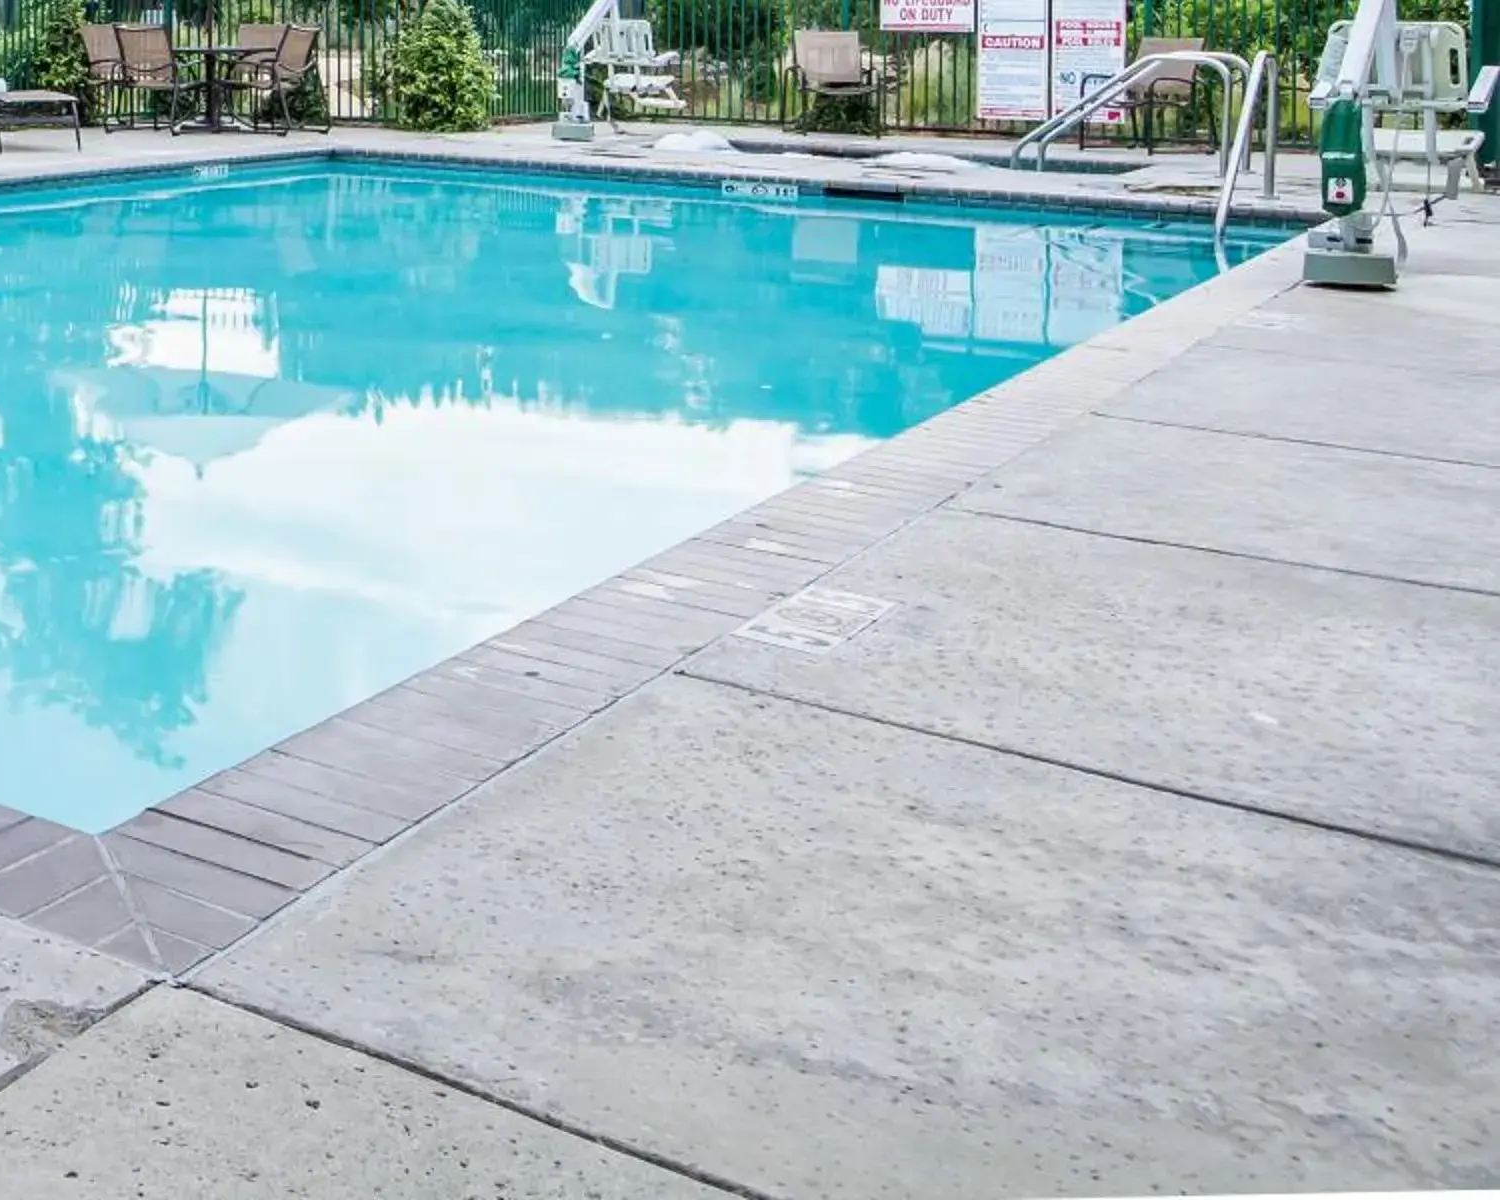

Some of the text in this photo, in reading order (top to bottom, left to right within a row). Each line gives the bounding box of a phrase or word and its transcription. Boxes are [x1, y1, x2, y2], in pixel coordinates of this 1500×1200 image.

[900, 8, 952, 21] ON DUTY
[985, 37, 1040, 48] CAUTION
